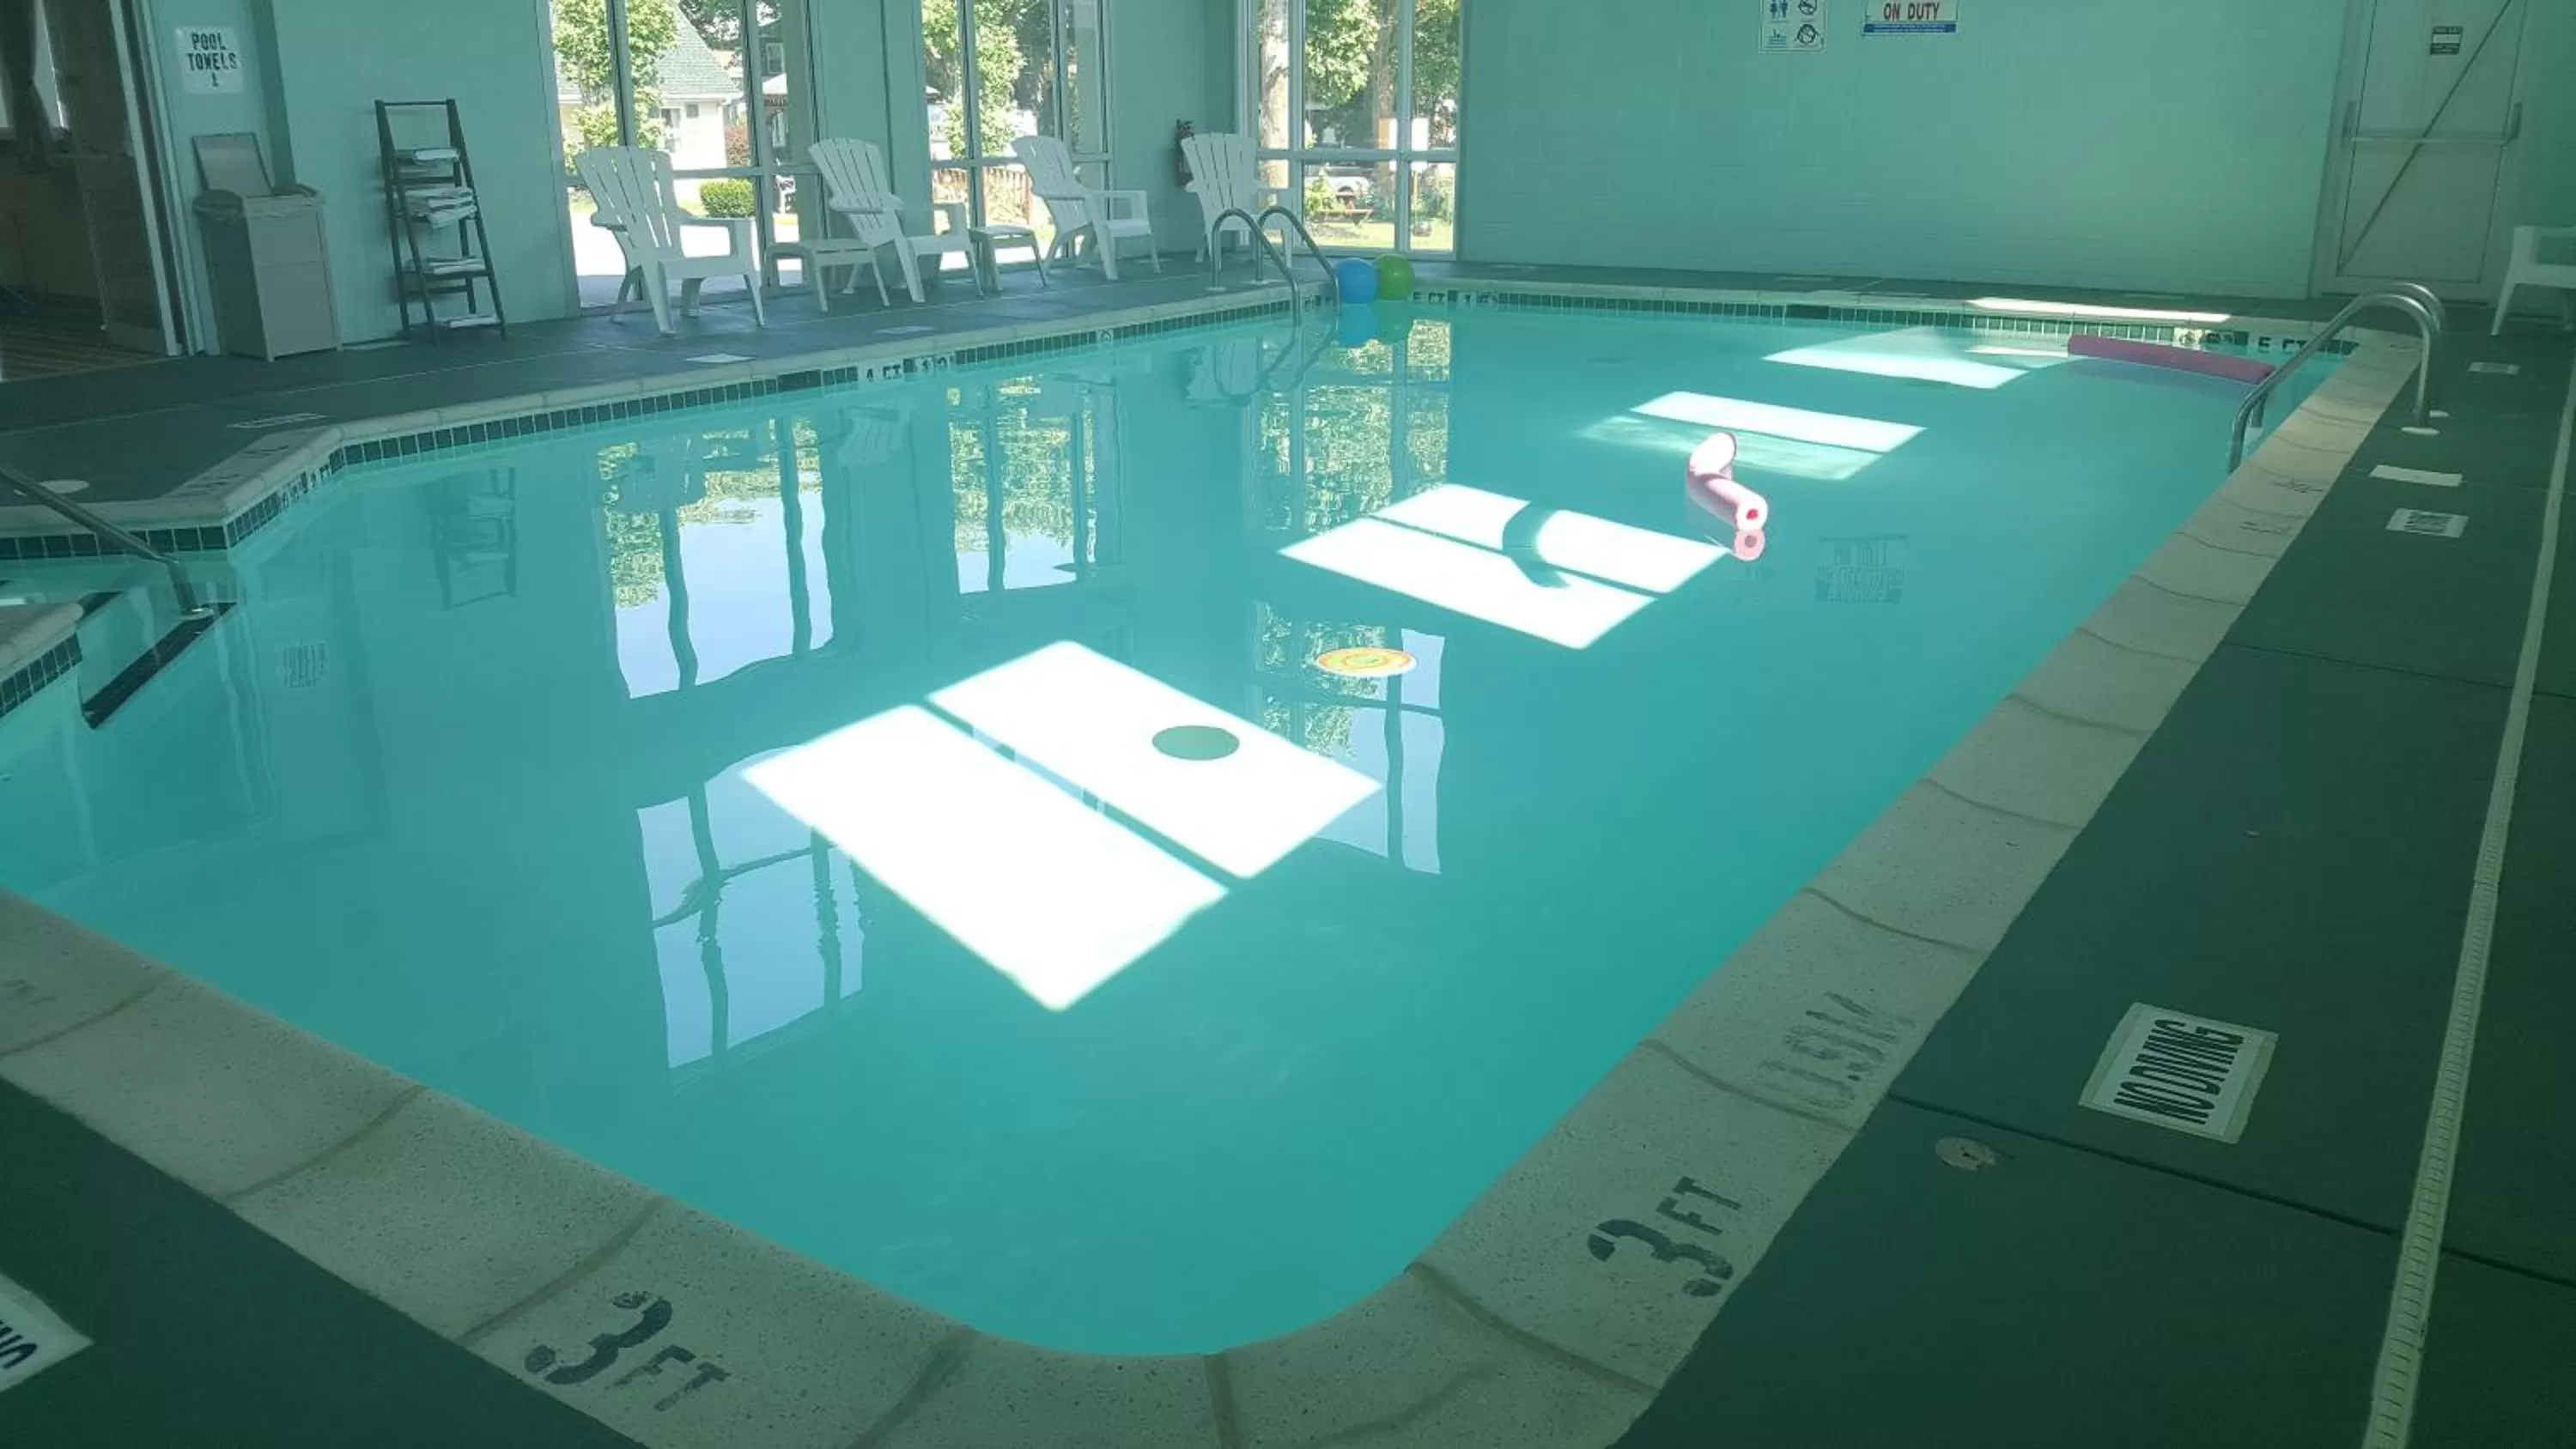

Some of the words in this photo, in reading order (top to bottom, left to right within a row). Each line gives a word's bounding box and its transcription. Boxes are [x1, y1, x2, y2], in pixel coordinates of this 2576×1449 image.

[1883, 2, 1901, 21] ON
[1907, 2, 1941, 21] DUTY
[186, 52, 238, 70] TOWELS
[191, 32, 228, 51] POOL
[2129, 1019, 2244, 1096] DIVING
[2113, 1081, 2215, 1125] NO
[1656, 1174, 1743, 1236] FT
[1587, 1218, 1734, 1298] 3
[525, 1290, 673, 1385] 3
[606, 1344, 732, 1412] FT
